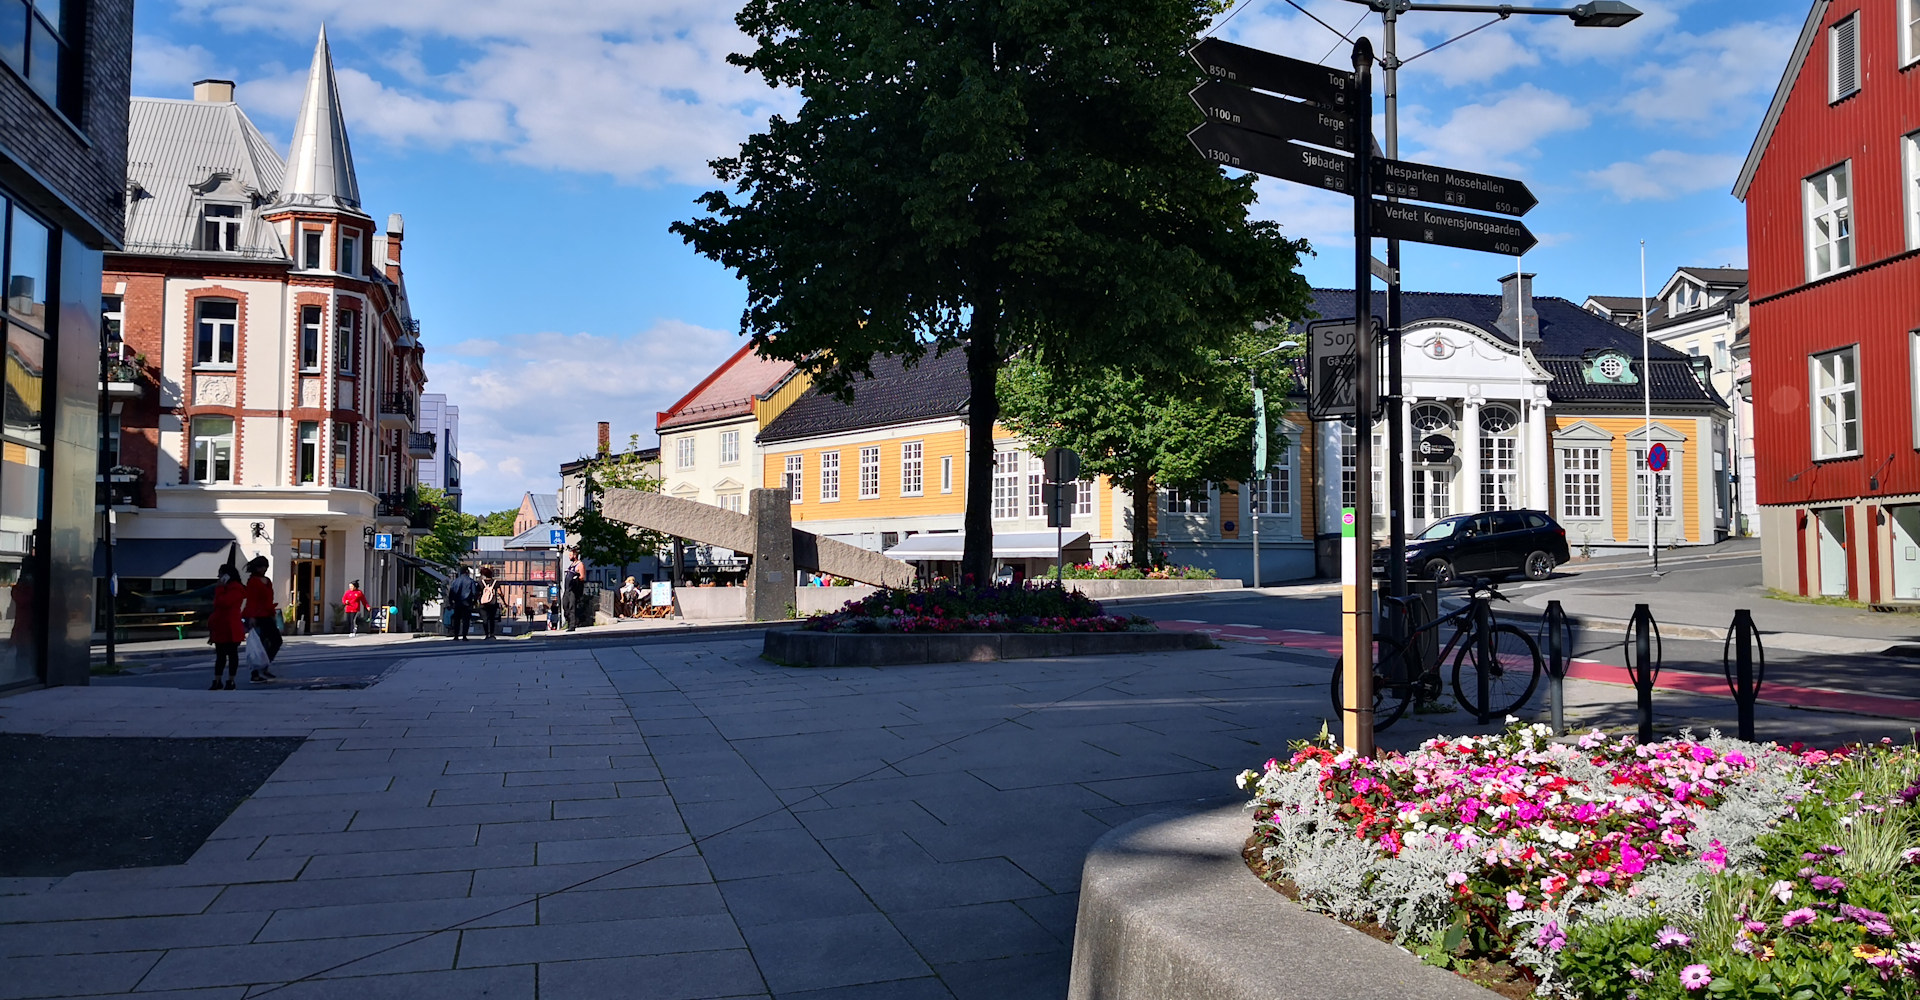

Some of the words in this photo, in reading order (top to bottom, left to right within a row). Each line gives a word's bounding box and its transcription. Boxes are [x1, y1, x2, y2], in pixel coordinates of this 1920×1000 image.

[1209, 65, 1227, 77] 850
[1328, 73, 1345, 90] Tog
[1209, 107, 1231, 121] 1100
[1232, 115, 1241, 123] m
[1318, 113, 1345, 131] Ferge
[1208, 149, 1230, 162] 1300
[1231, 157, 1240, 165] m
[1302, 152, 1345, 172] Sjøbadet
[1386, 164, 1440, 183] Nesparken
[1445, 174, 1505, 194] Mossehallen
[1495, 201, 1511, 212] 650
[1512, 206, 1520, 214] m
[1385, 206, 1418, 222] Verket
[1424, 212, 1521, 237] Konvensjonsgaarden
[1494, 242, 1510, 253] 400
[1323, 330, 1356, 347] Son
